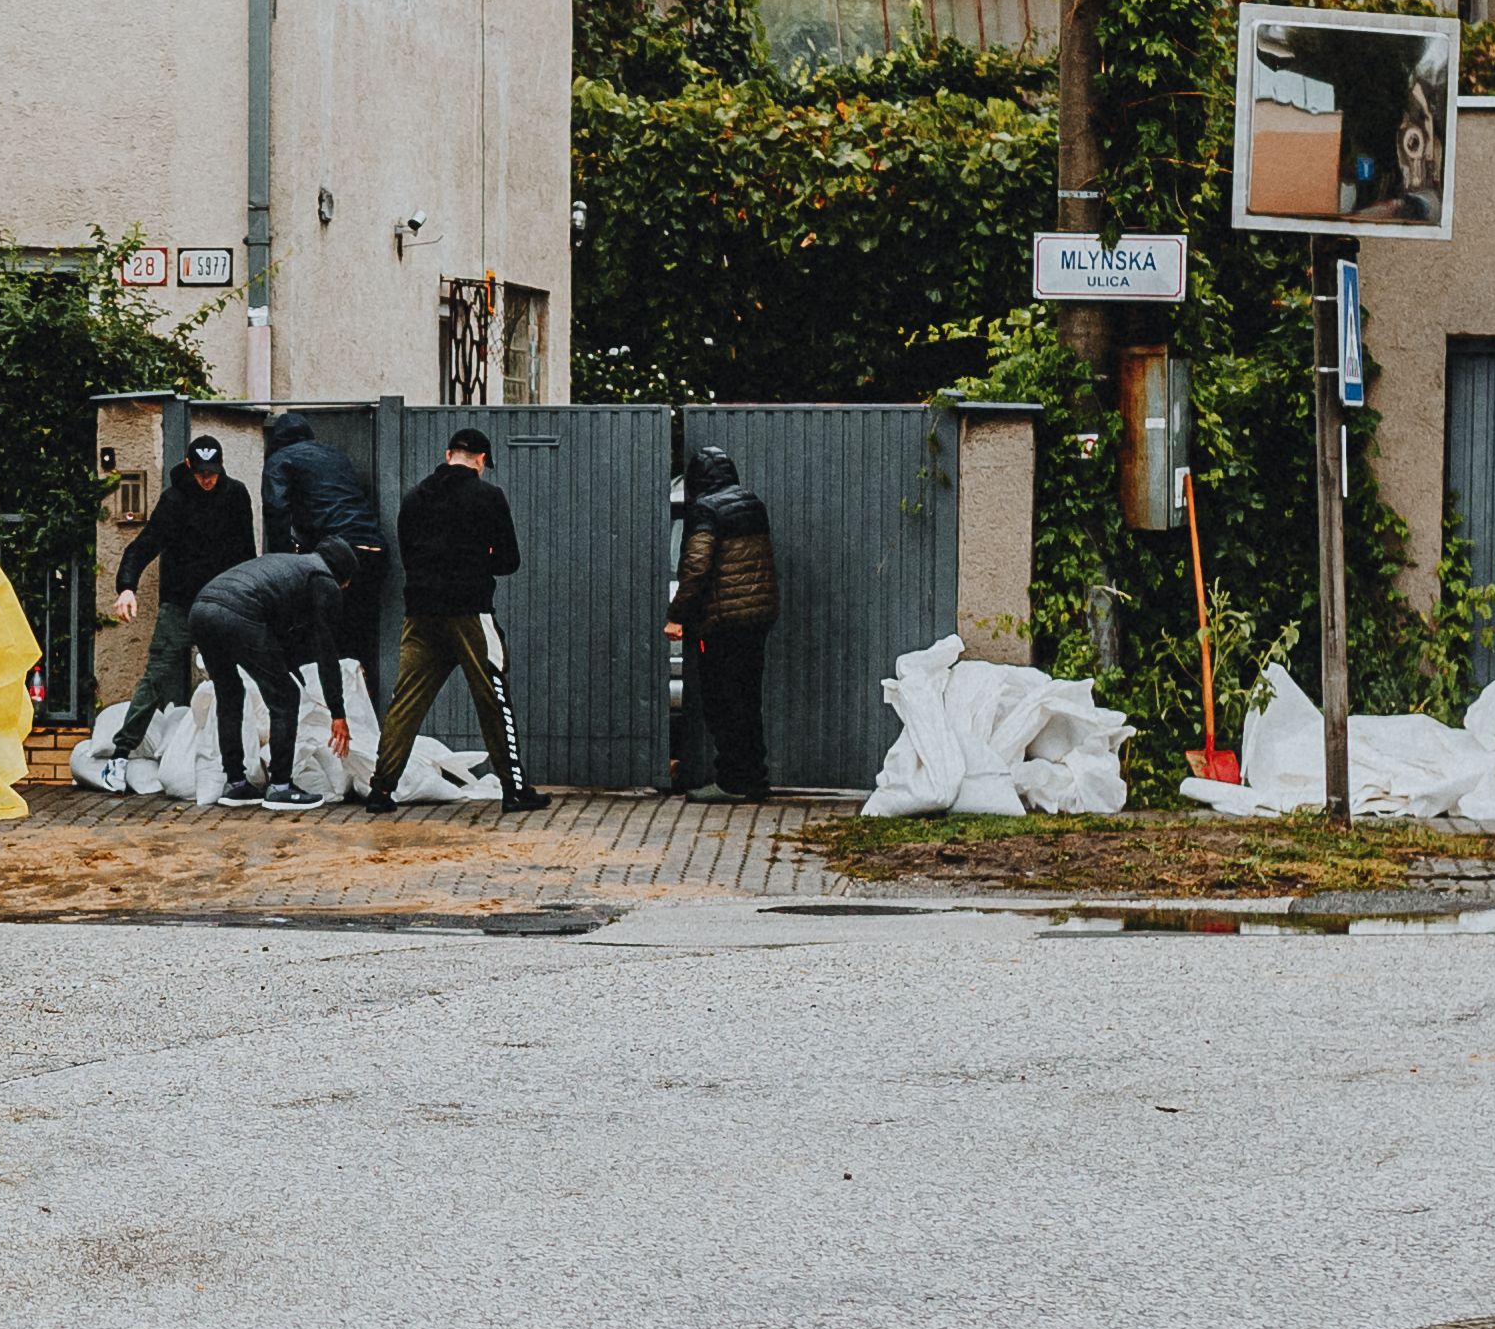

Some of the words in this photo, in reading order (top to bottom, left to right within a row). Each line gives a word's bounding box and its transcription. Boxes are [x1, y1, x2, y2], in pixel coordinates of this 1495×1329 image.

[133, 256, 155, 277] 28
[197, 256, 227, 276] 5977
[1061, 246, 1157, 270] MLYNSKÁ
[1087, 276, 1130, 287] ULICA
[502, 706, 519, 761] SPORTS
